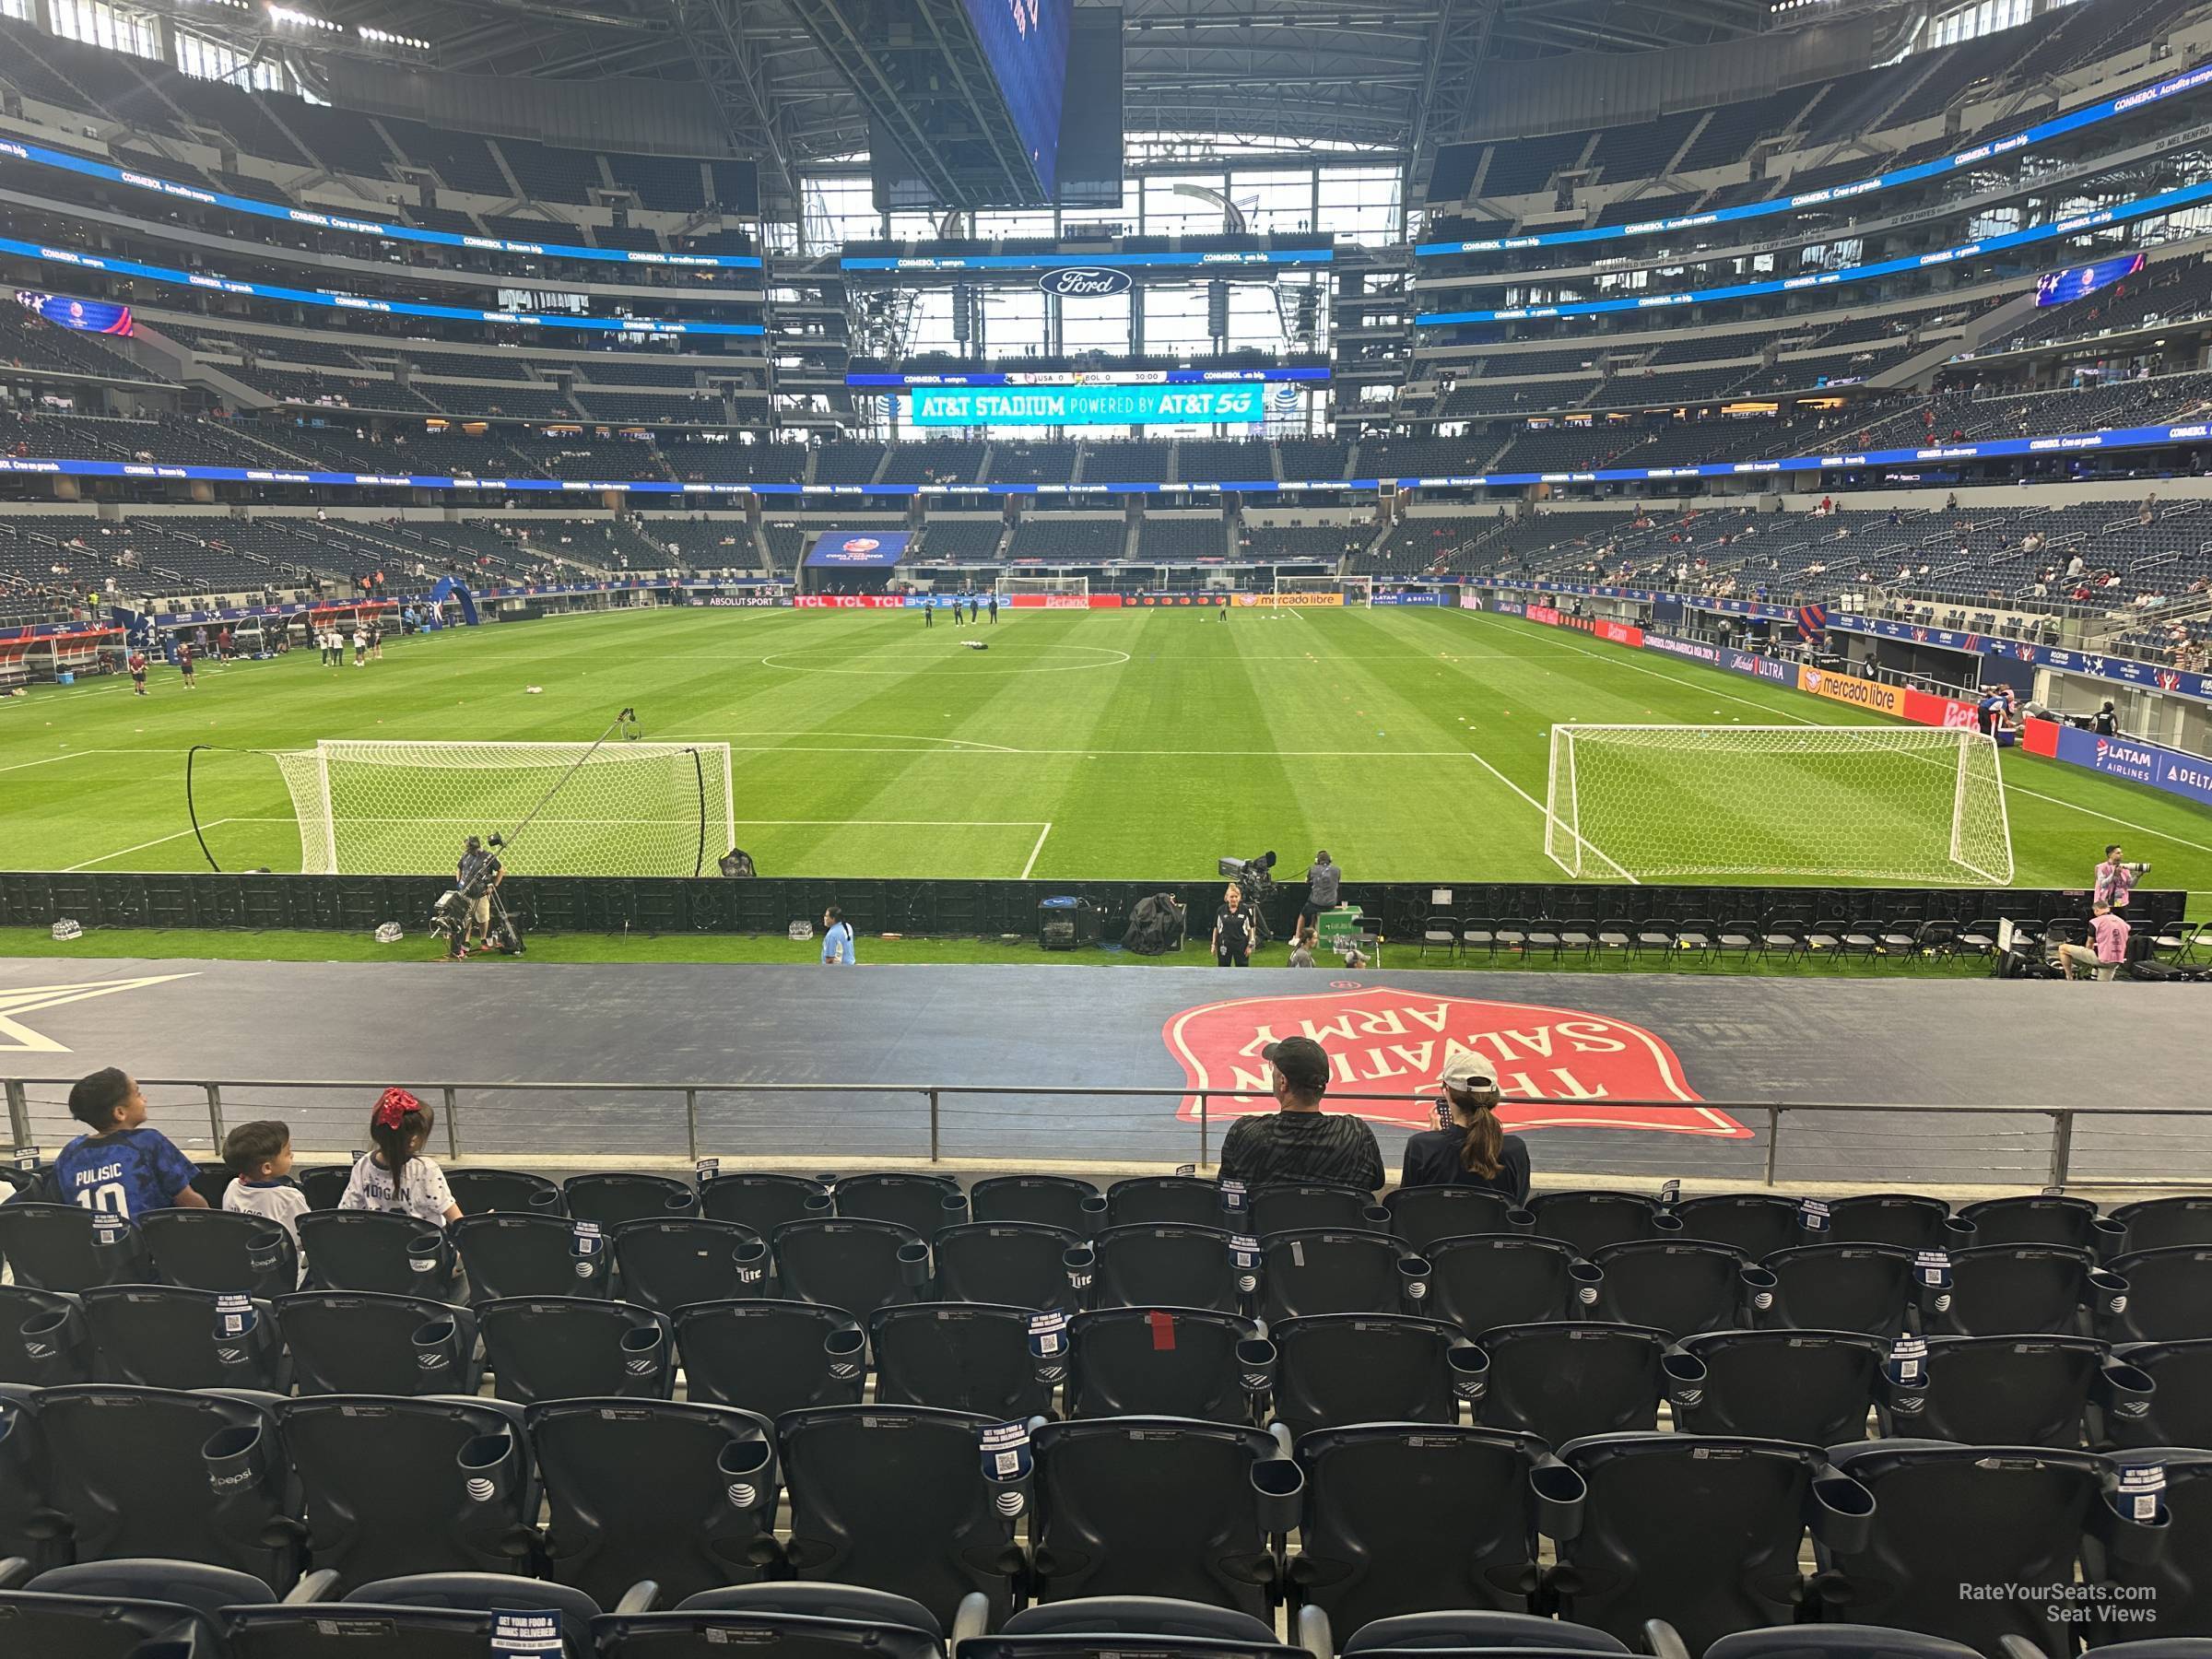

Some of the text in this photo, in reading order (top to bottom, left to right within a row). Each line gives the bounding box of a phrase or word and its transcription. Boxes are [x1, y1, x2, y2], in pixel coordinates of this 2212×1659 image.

[2114, 88, 2158, 112] CONMEBOL
[1955, 147, 1991, 165] CONMEBOL
[123, 172, 162, 190] CONMEBOL
[1792, 192, 1830, 206] CONMEBOL
[290, 210, 329, 225] CONMEBOL
[2057, 218, 2091, 231] CONMEBOL
[1625, 221, 1664, 234] CONMEBOL
[464, 237, 502, 249] CONMEBOL
[1463, 241, 1501, 252] CONMEBOL
[41, 249, 80, 263] CONMEBOL
[629, 253, 667, 262] CONMEBOL
[190, 276, 222, 288] CONMEBOL
[1056, 271, 1114, 293] Ford
[1639, 297, 1672, 305] CONMEBOL
[1085, 373, 1100, 382] BOL
[1135, 372, 1159, 381] 30:00
[922, 392, 1253, 418] AT&T STADIUM POWERED BY AT&T 5G
[2030, 440, 2061, 449] CONMEBOL
[710, 597, 746, 606] ABSOLUT
[747, 597, 774, 606] SPORT
[795, 595, 904, 606] TCL TCL TCL
[905, 595, 937, 606] BYD
[1310, 594, 1335, 605] libre
[1702, 647, 1714, 661] 2024
[1759, 662, 1784, 680] ULTRA
[1823, 677, 1895, 710] mercado libre
[2109, 745, 2151, 768] LATAM
[2107, 762, 2149, 781] AIRLINES
[1239, 1003, 1453, 1057] ARMY
[1229, 1021, 1627, 1104] SALVATIN
[76, 1163, 123, 1186] PULISIC
[363, 1184, 411, 1203] MORGN
[76, 1182, 129, 1220] 10
[735, 1265, 762, 1283] Lite
[1067, 1271, 1092, 1288] Lite
[218, 1467, 252, 1485] pepsi
[499, 1616, 510, 1626] GET
[511, 1617, 528, 1628] YOUR
[528, 1618, 547, 1628] FOOD
[496, 1625, 518, 1637] DRINKS
